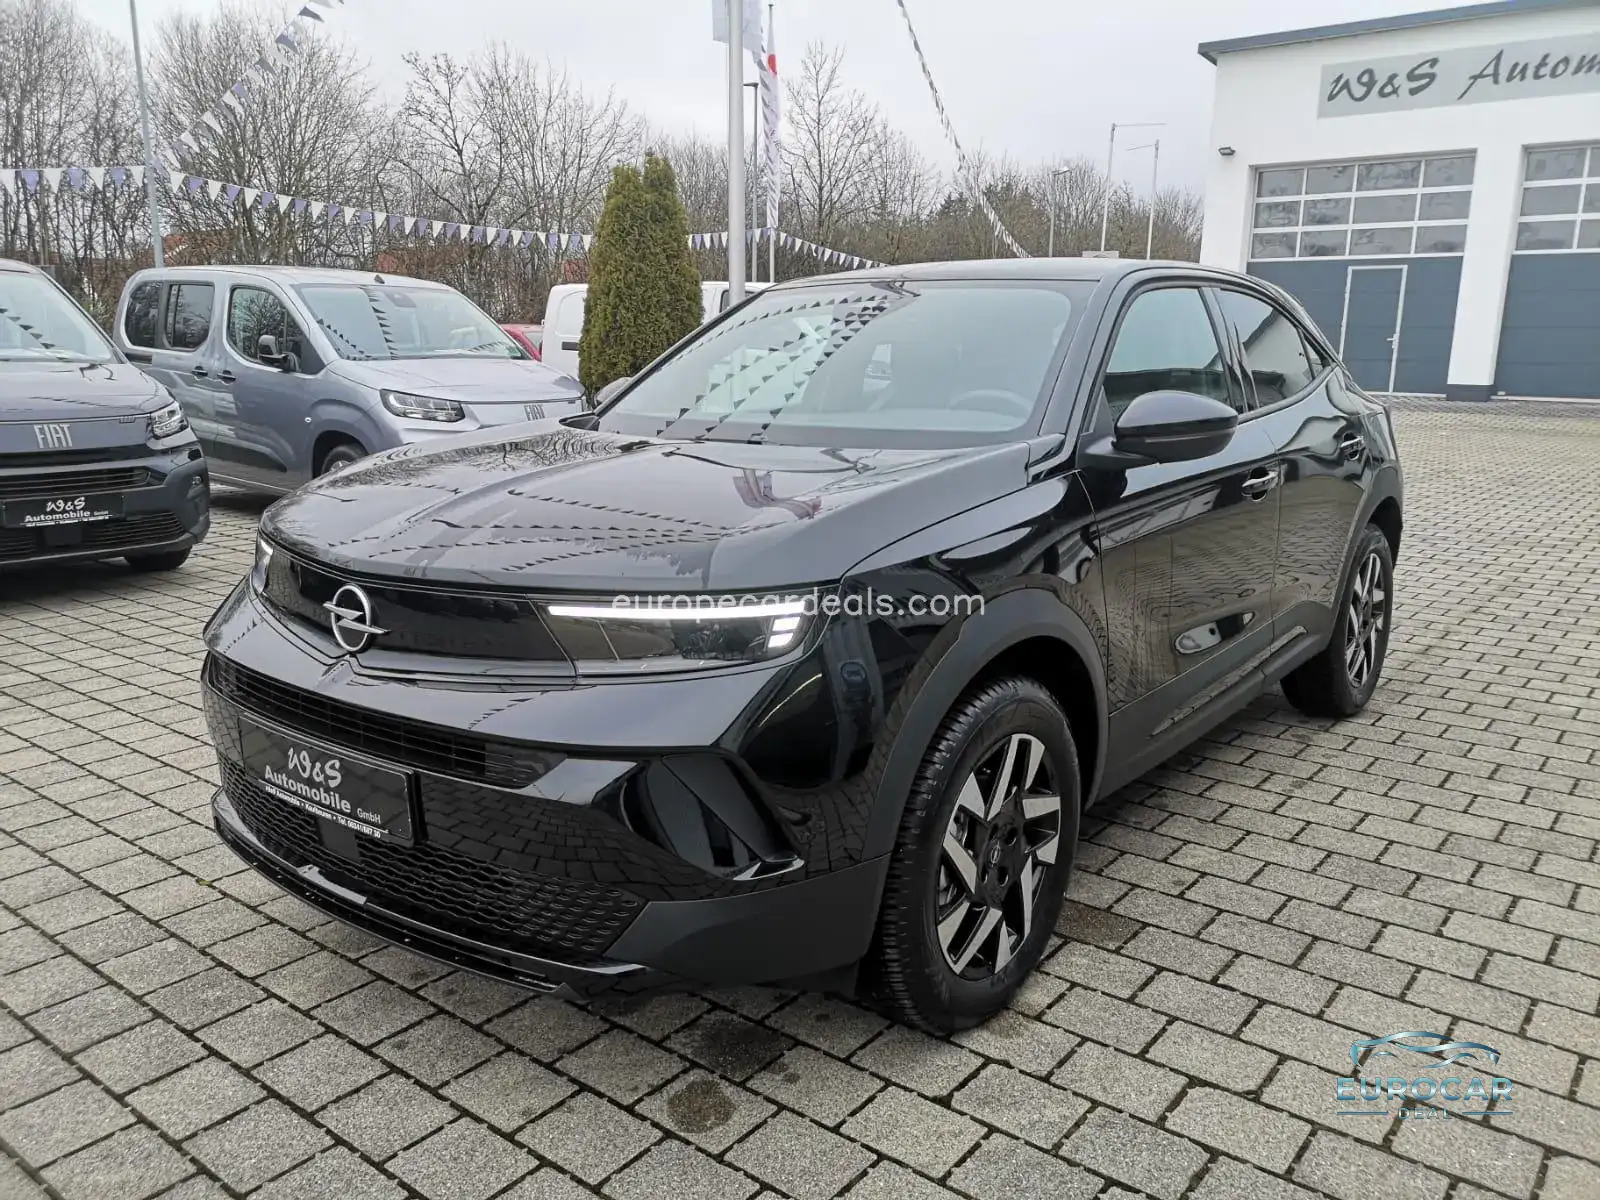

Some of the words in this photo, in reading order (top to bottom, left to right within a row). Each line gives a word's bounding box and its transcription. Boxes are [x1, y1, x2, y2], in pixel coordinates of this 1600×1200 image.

[33, 423, 73, 449] FIAT
[24, 510, 91, 523] Automobile
[287, 747, 342, 788] W&S
[264, 765, 352, 813] Automobile
[356, 807, 381, 825] GmbH
